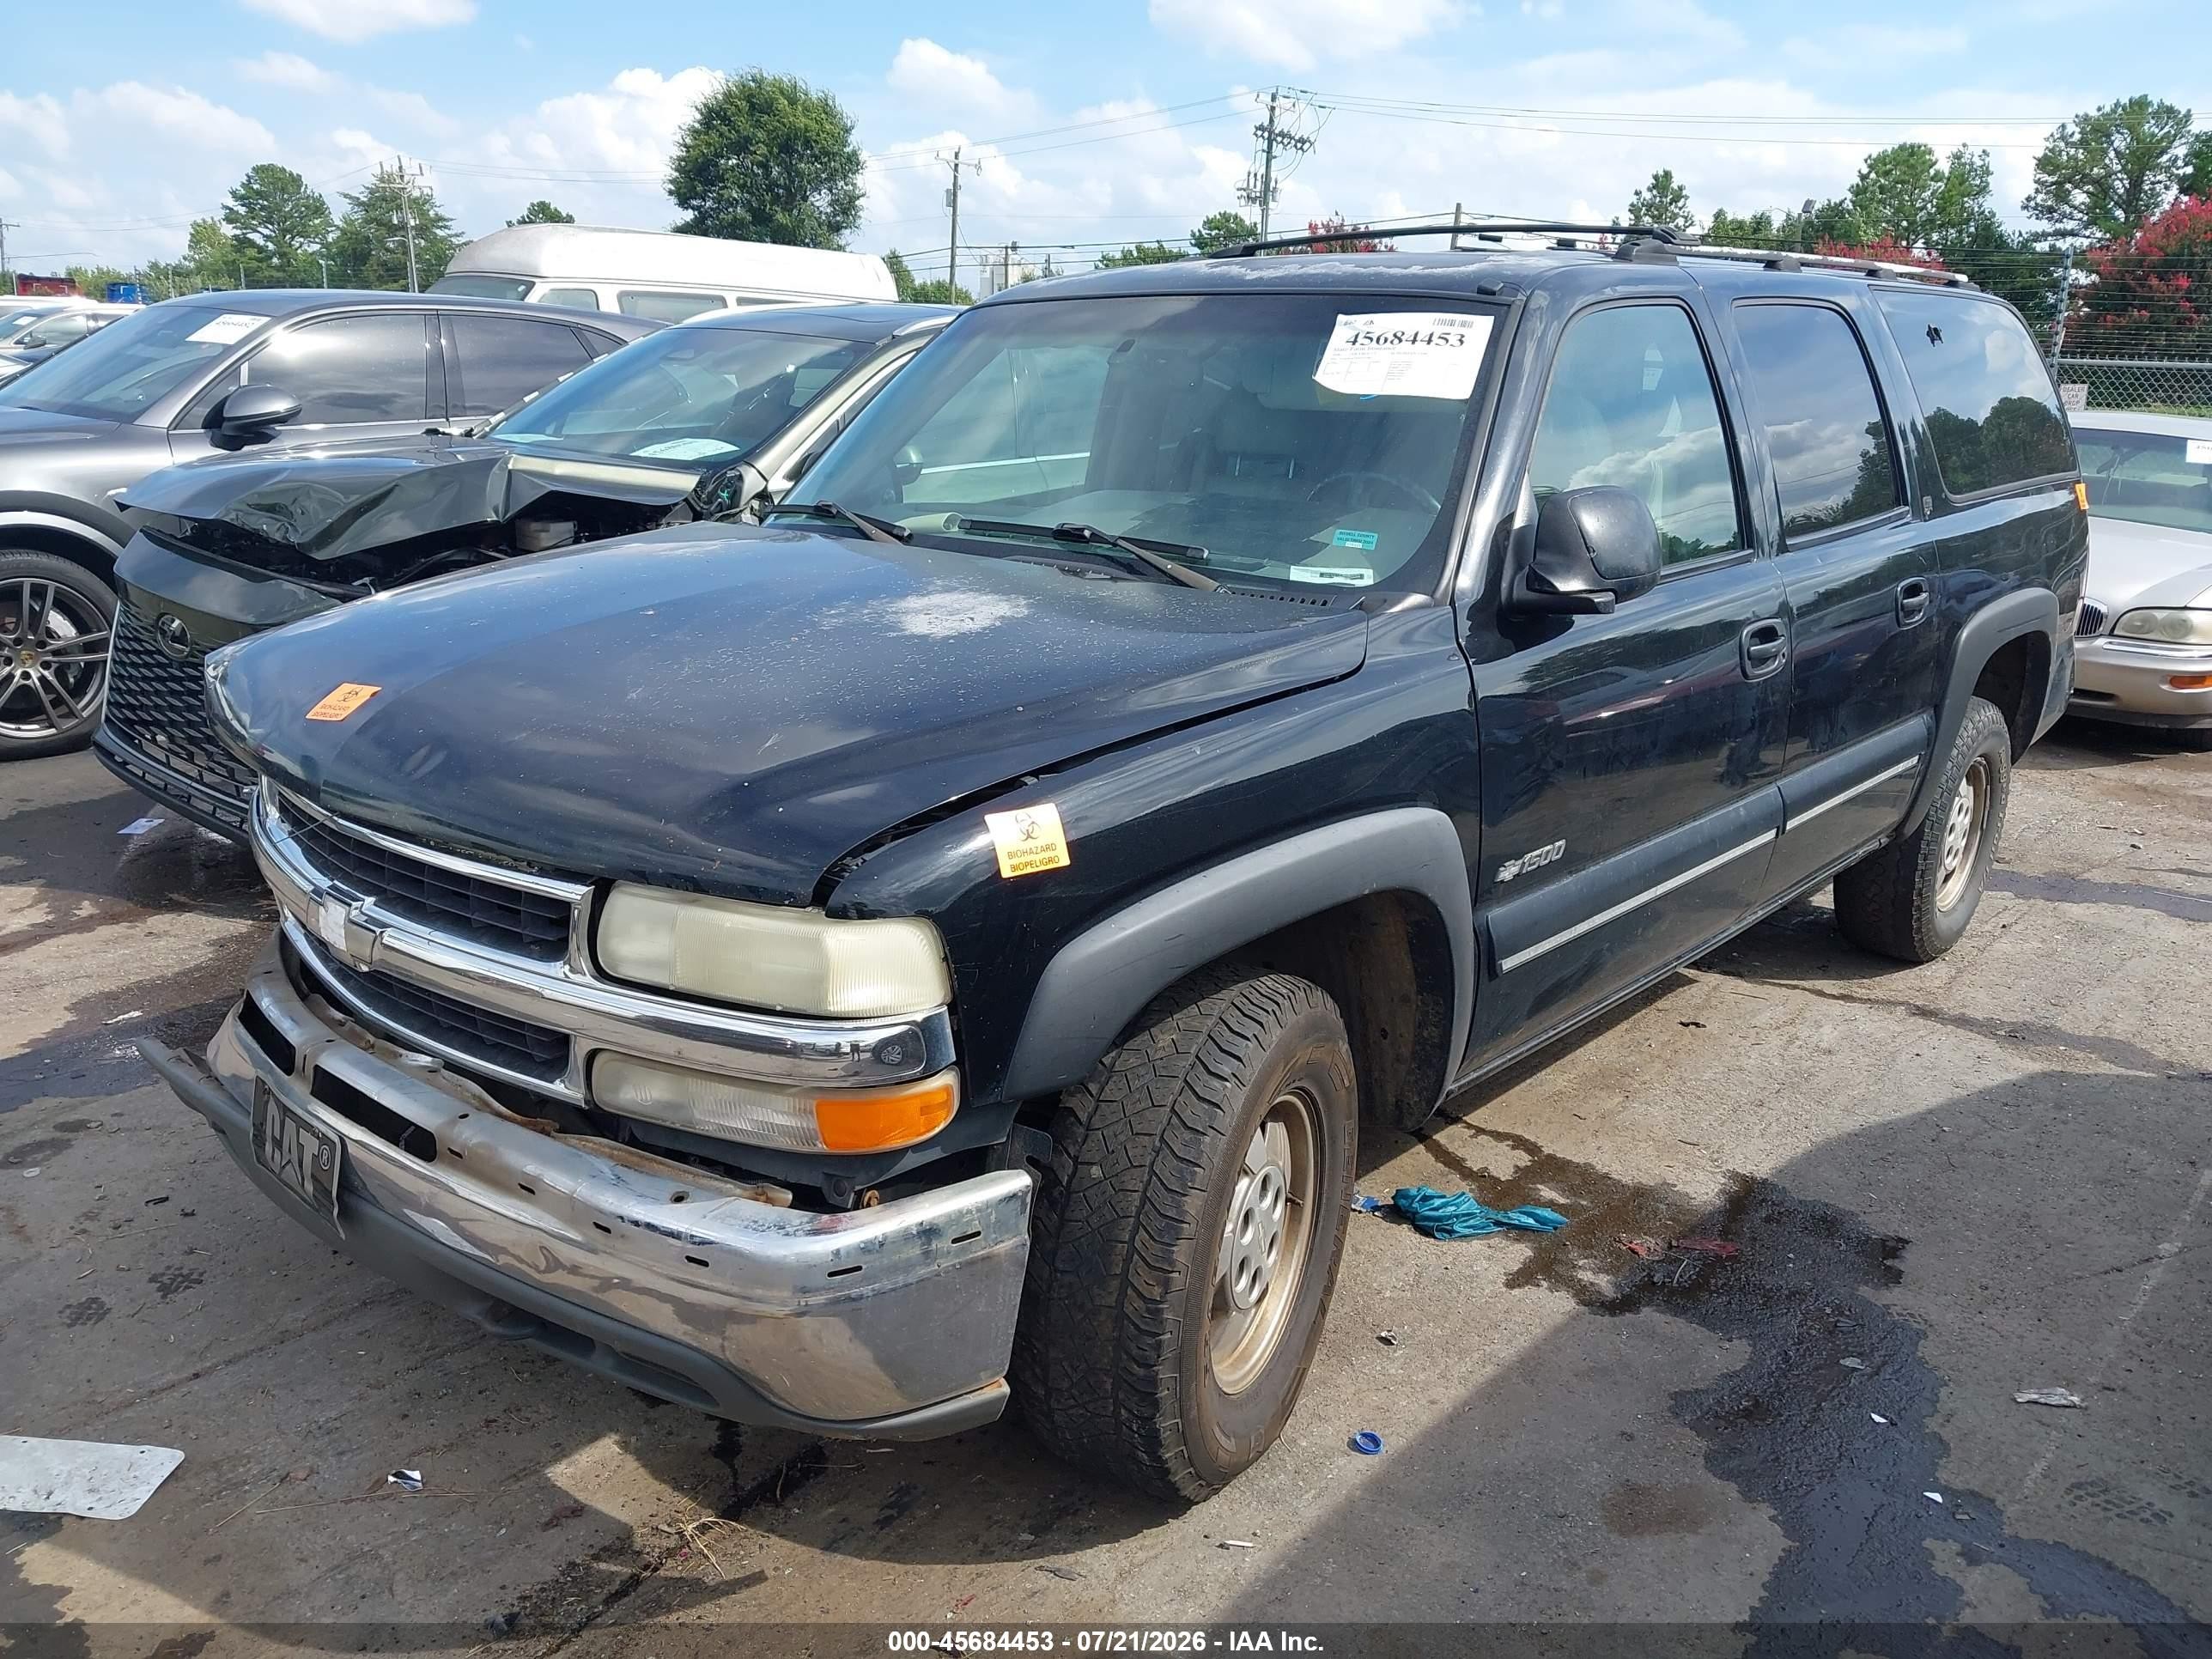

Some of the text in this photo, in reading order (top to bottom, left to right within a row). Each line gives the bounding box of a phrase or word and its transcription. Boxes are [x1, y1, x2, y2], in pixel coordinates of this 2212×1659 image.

[1346, 330, 1466, 348] 45684453
[1007, 842, 1057, 860] BIOHAZARD
[1521, 839, 1566, 875] 1500
[1010, 855, 1060, 872] BIOPELIGRO
[265, 1097, 319, 1204] CAT
